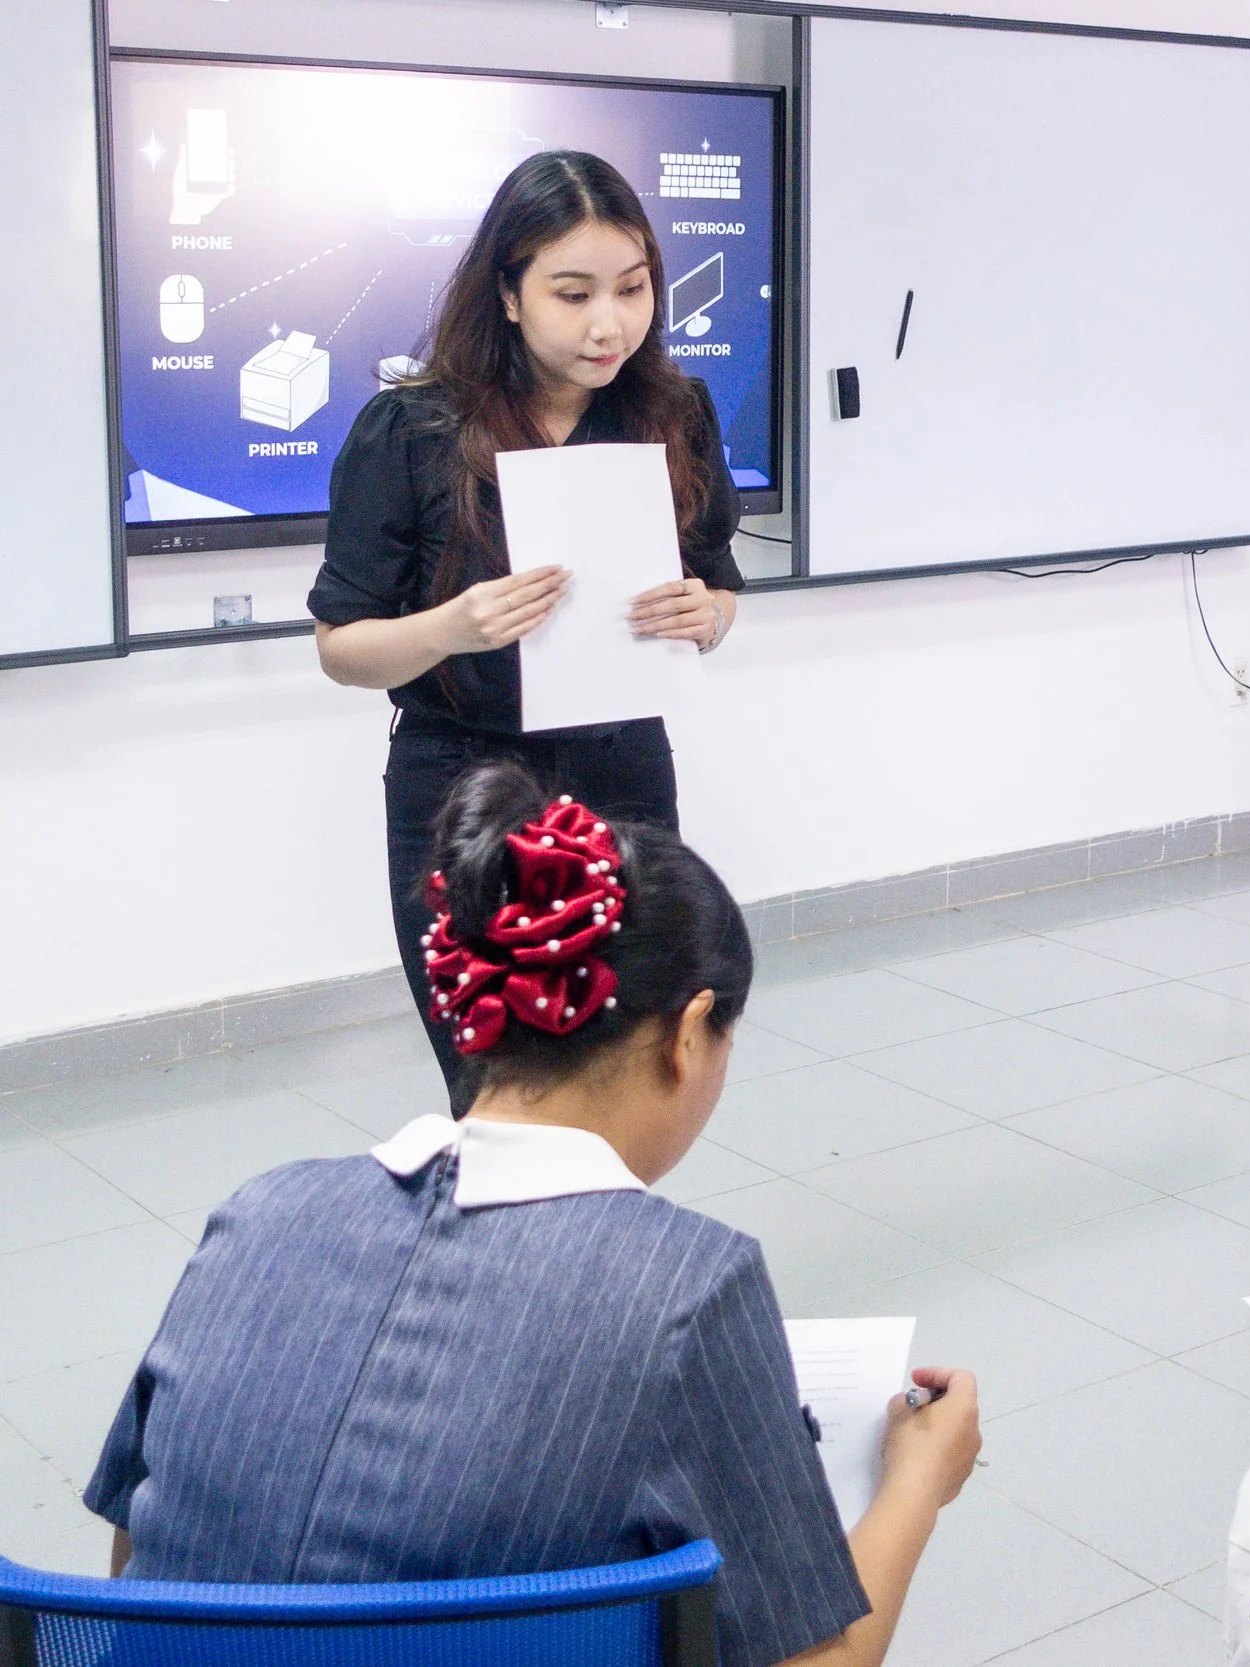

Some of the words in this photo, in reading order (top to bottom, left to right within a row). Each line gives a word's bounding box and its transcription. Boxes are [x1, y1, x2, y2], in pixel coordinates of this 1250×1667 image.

[672, 221, 746, 235] KEYBROAD
[171, 235, 233, 250] PHONE
[668, 343, 732, 357] MONITOR
[151, 355, 215, 371] MOUSE
[248, 441, 319, 457] PRINTER
